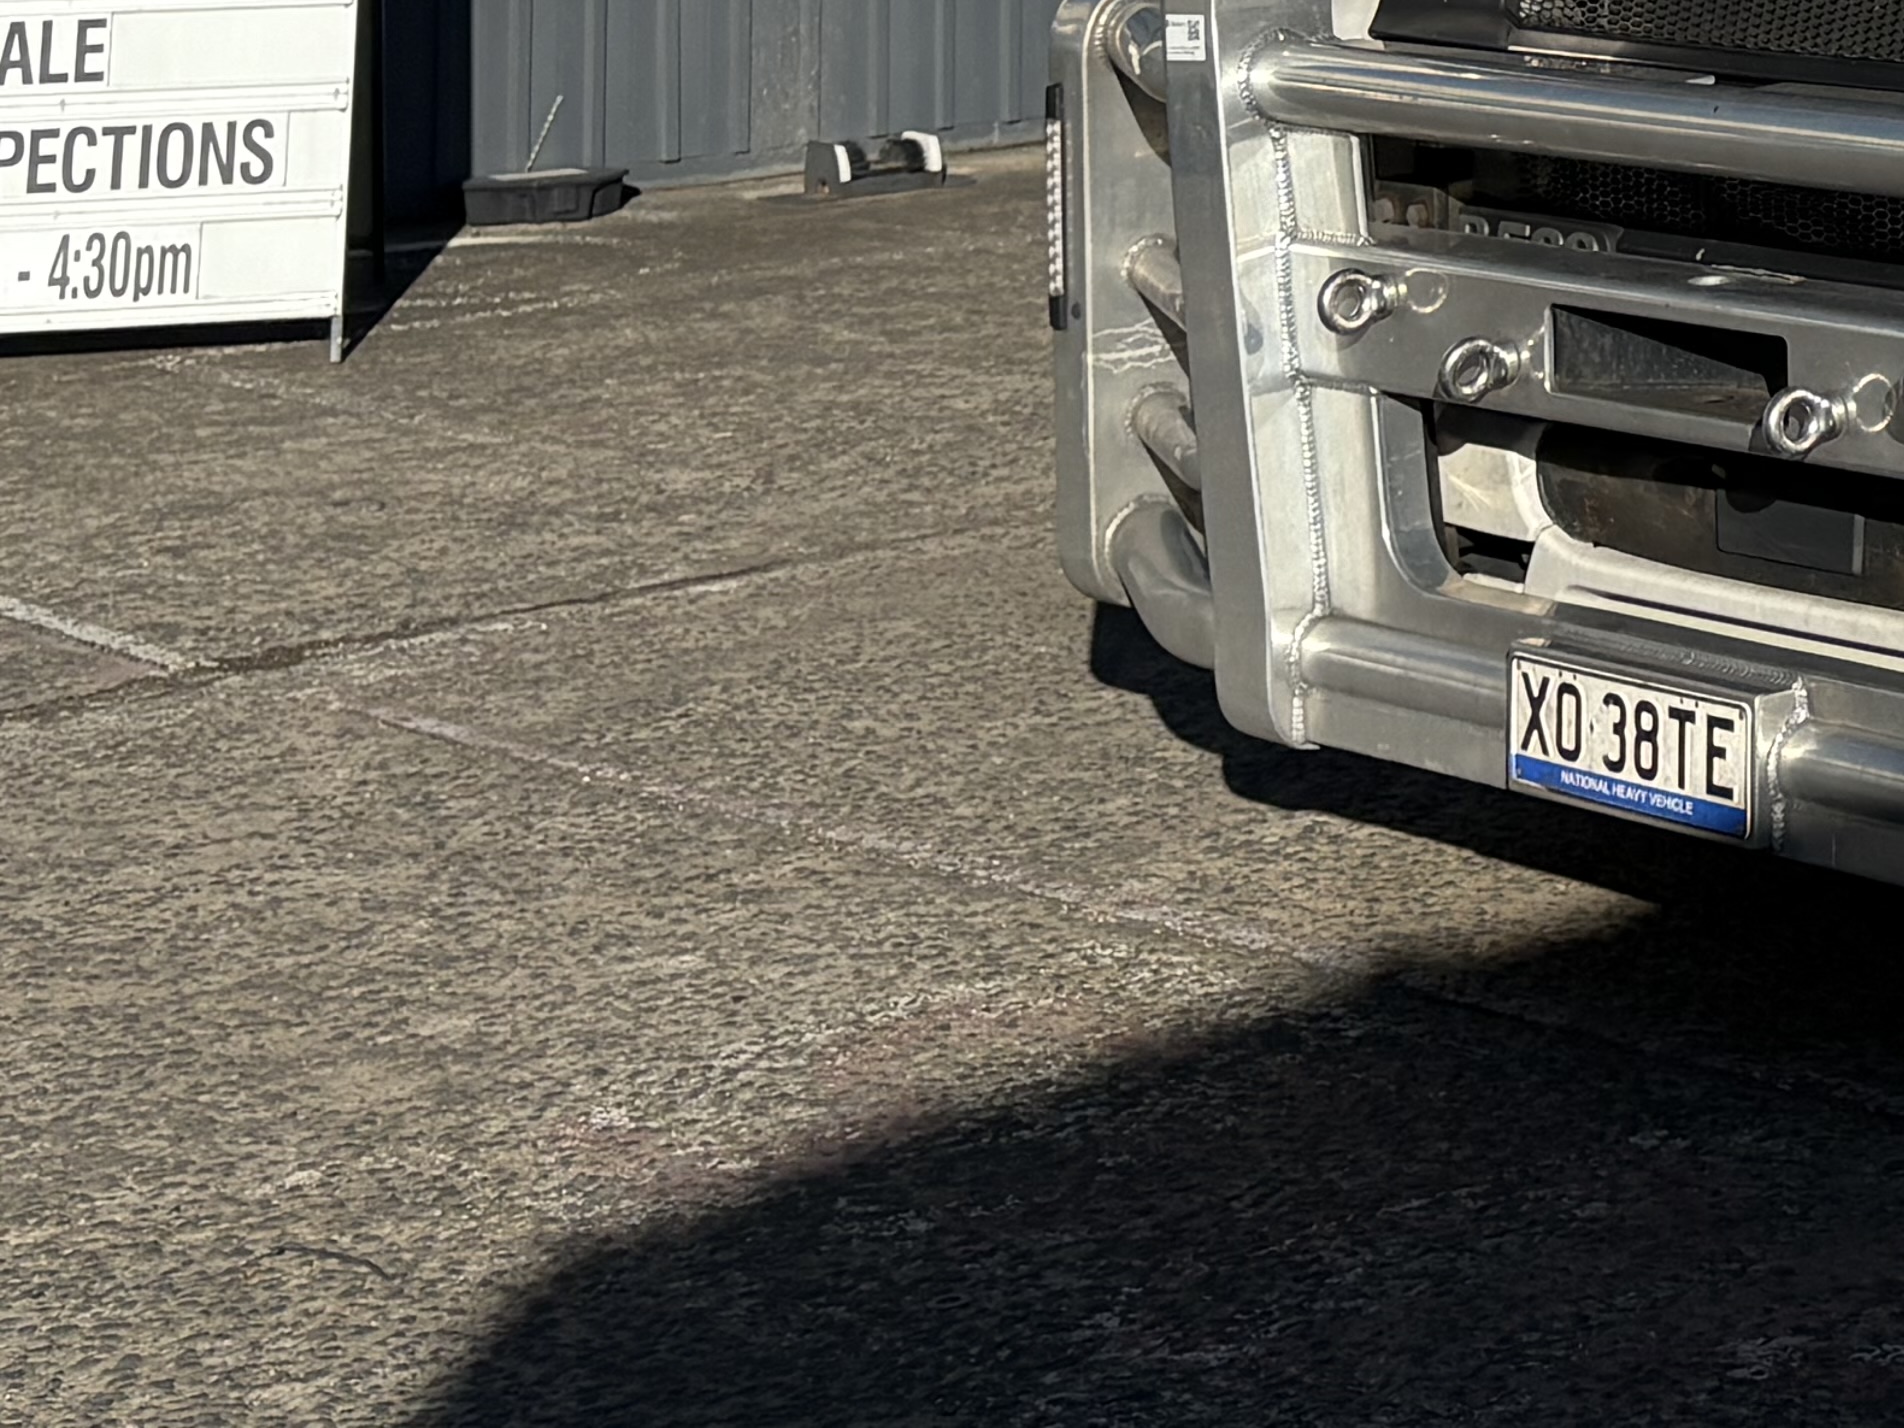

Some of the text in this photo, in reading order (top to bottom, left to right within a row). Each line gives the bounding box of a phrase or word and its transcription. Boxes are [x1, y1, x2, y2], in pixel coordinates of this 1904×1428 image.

[48, 231, 192, 302] 4:30pm
[1560, 770, 1694, 815] NATIONAL HEAVY VEHICLE
